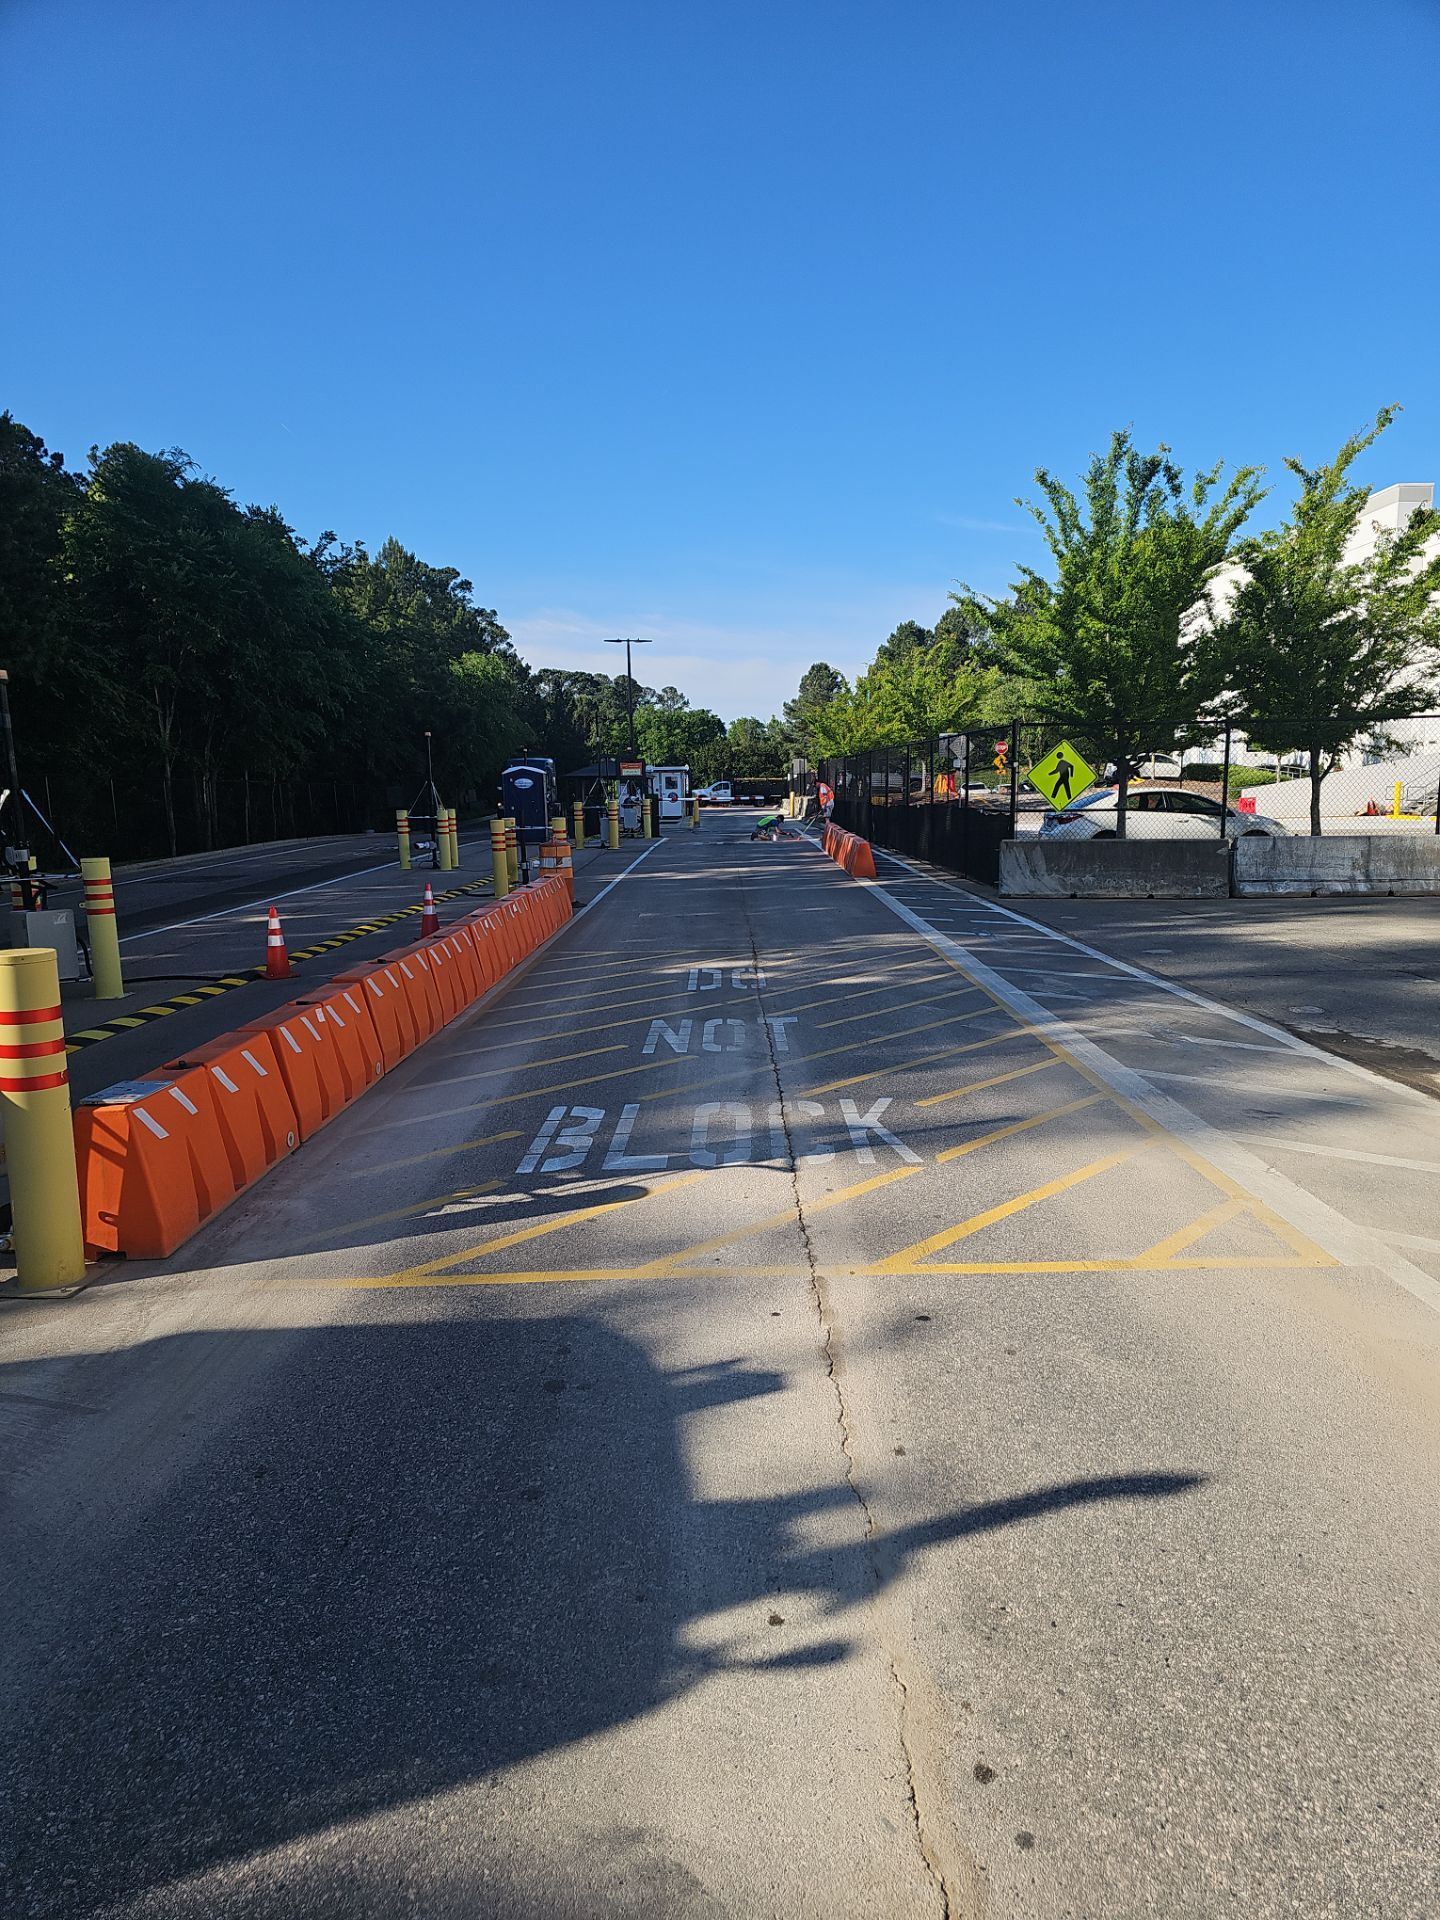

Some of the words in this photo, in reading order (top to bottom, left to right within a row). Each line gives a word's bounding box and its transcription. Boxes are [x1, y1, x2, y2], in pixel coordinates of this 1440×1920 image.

[687, 968, 767, 991] DO
[641, 1016, 798, 1054] NOT
[515, 1098, 924, 1174] BLOCK
